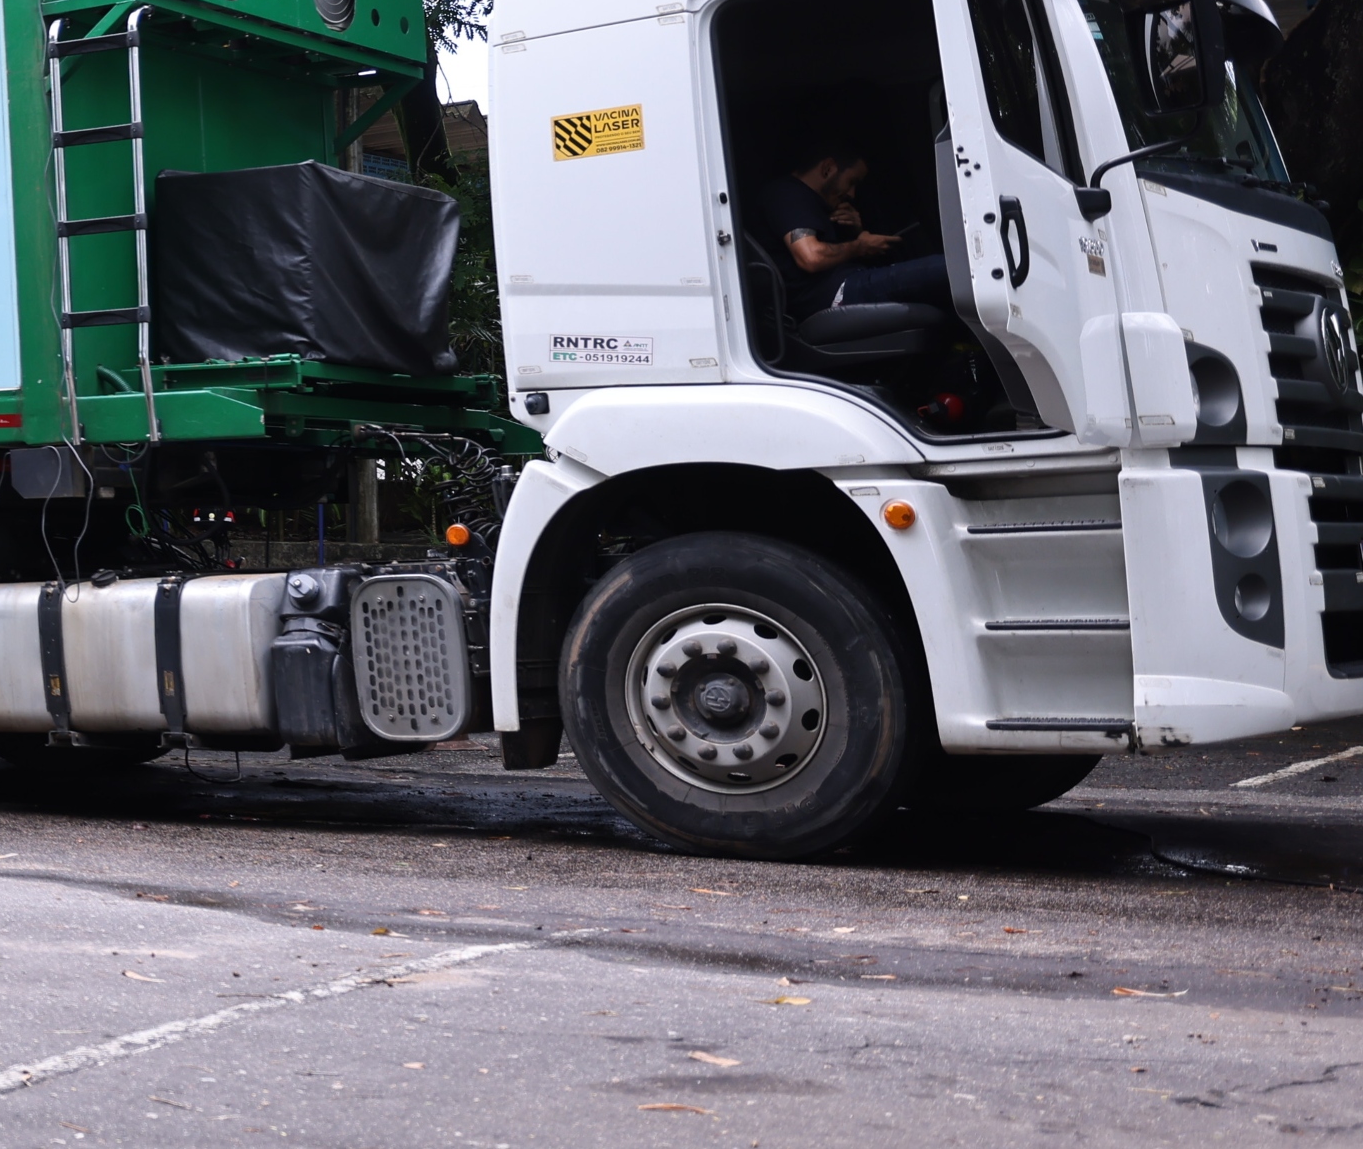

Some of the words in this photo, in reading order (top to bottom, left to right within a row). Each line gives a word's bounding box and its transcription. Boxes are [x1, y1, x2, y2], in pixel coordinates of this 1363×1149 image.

[593, 108, 639, 122] VACINA
[594, 118, 640, 134] LASER
[553, 336, 619, 350] RNTRC
[552, 352, 578, 361] ETC
